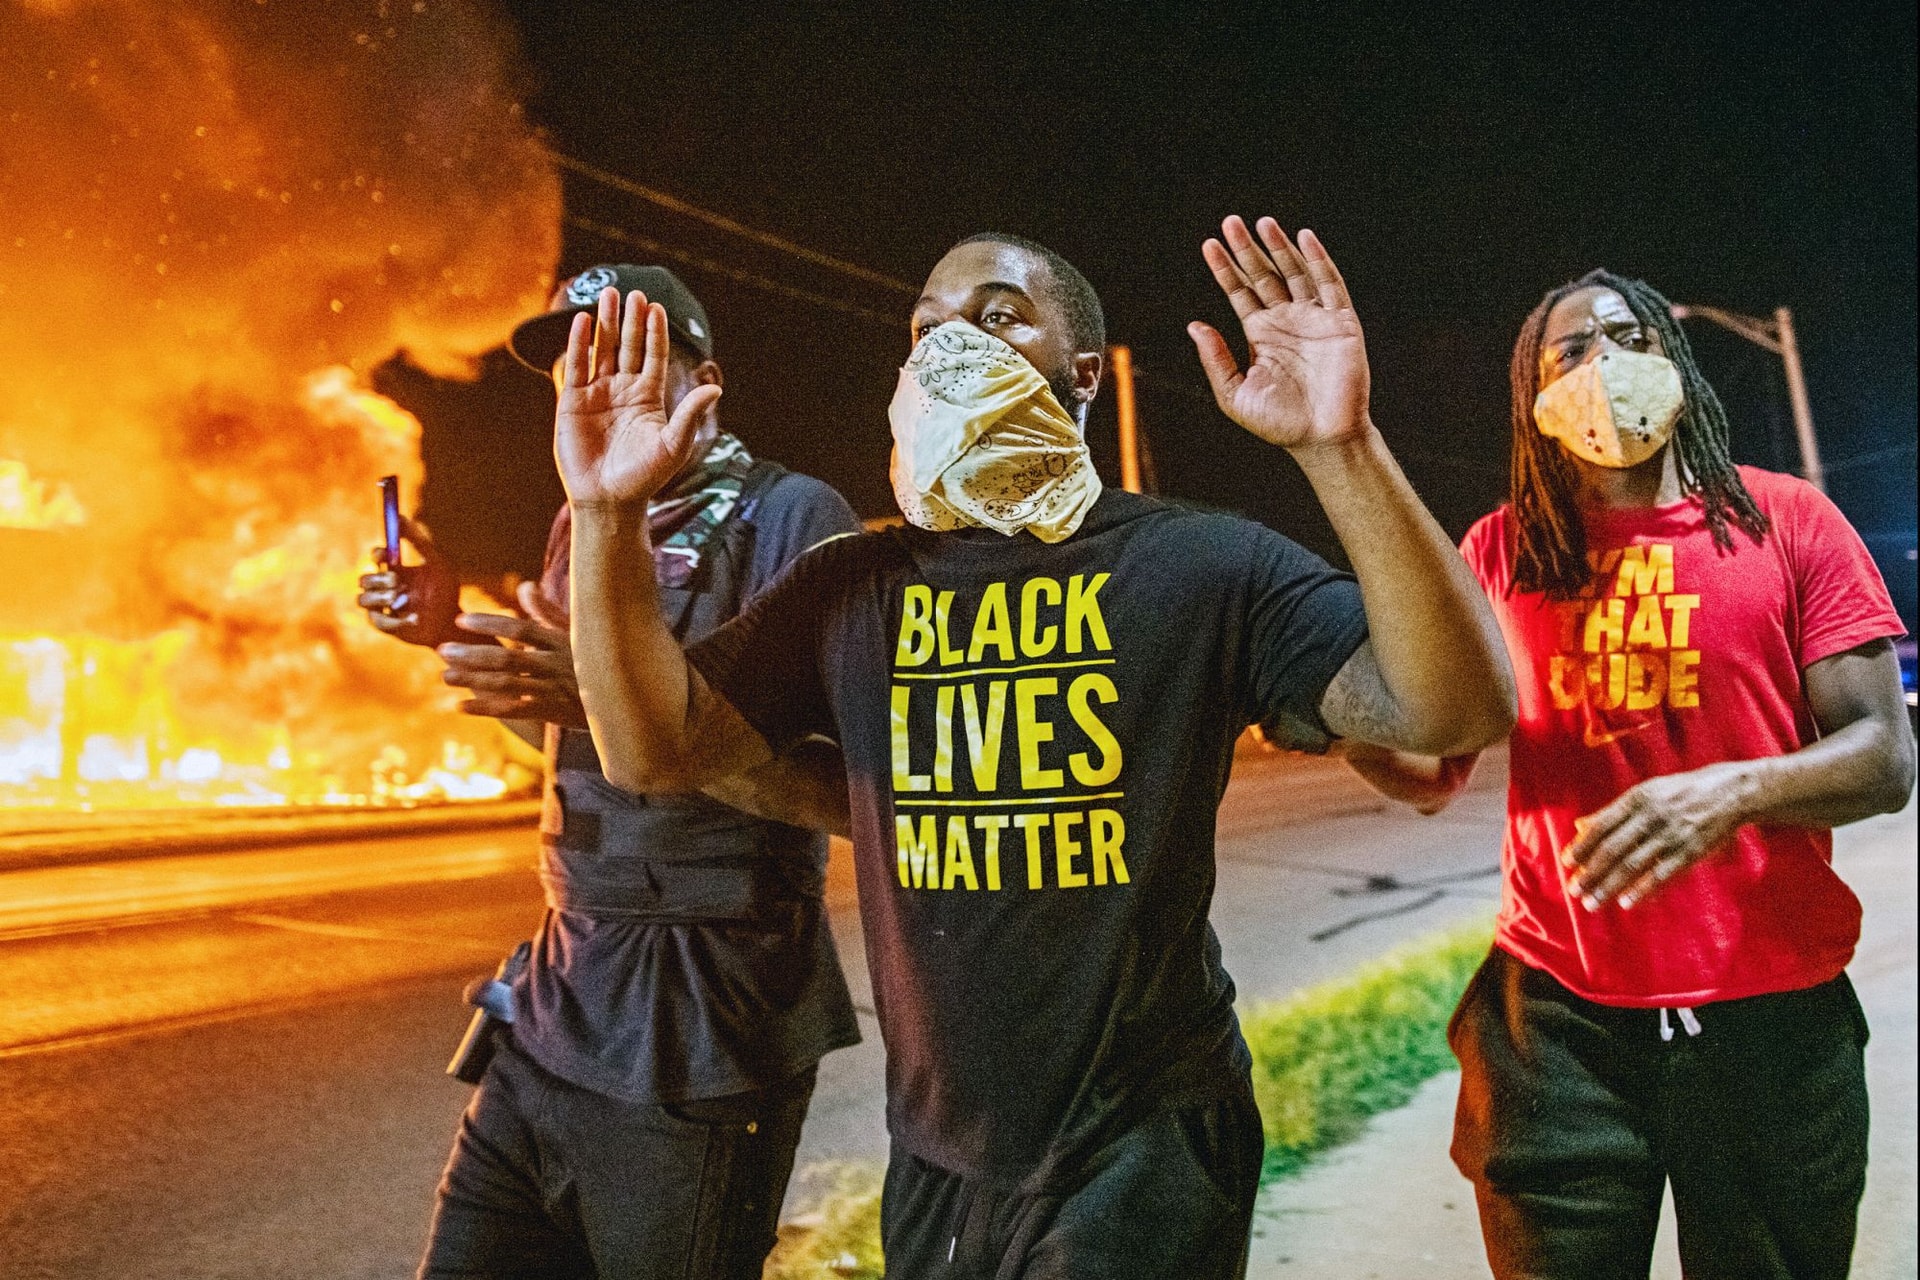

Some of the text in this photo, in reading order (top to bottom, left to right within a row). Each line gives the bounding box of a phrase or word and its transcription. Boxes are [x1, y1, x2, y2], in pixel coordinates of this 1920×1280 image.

[895, 573, 1112, 667] BLACK
[1553, 594, 1700, 653] THAT
[1549, 650, 1700, 710] DUDE
[891, 673, 1123, 792] LIVES
[895, 809, 1130, 891] MATTER
